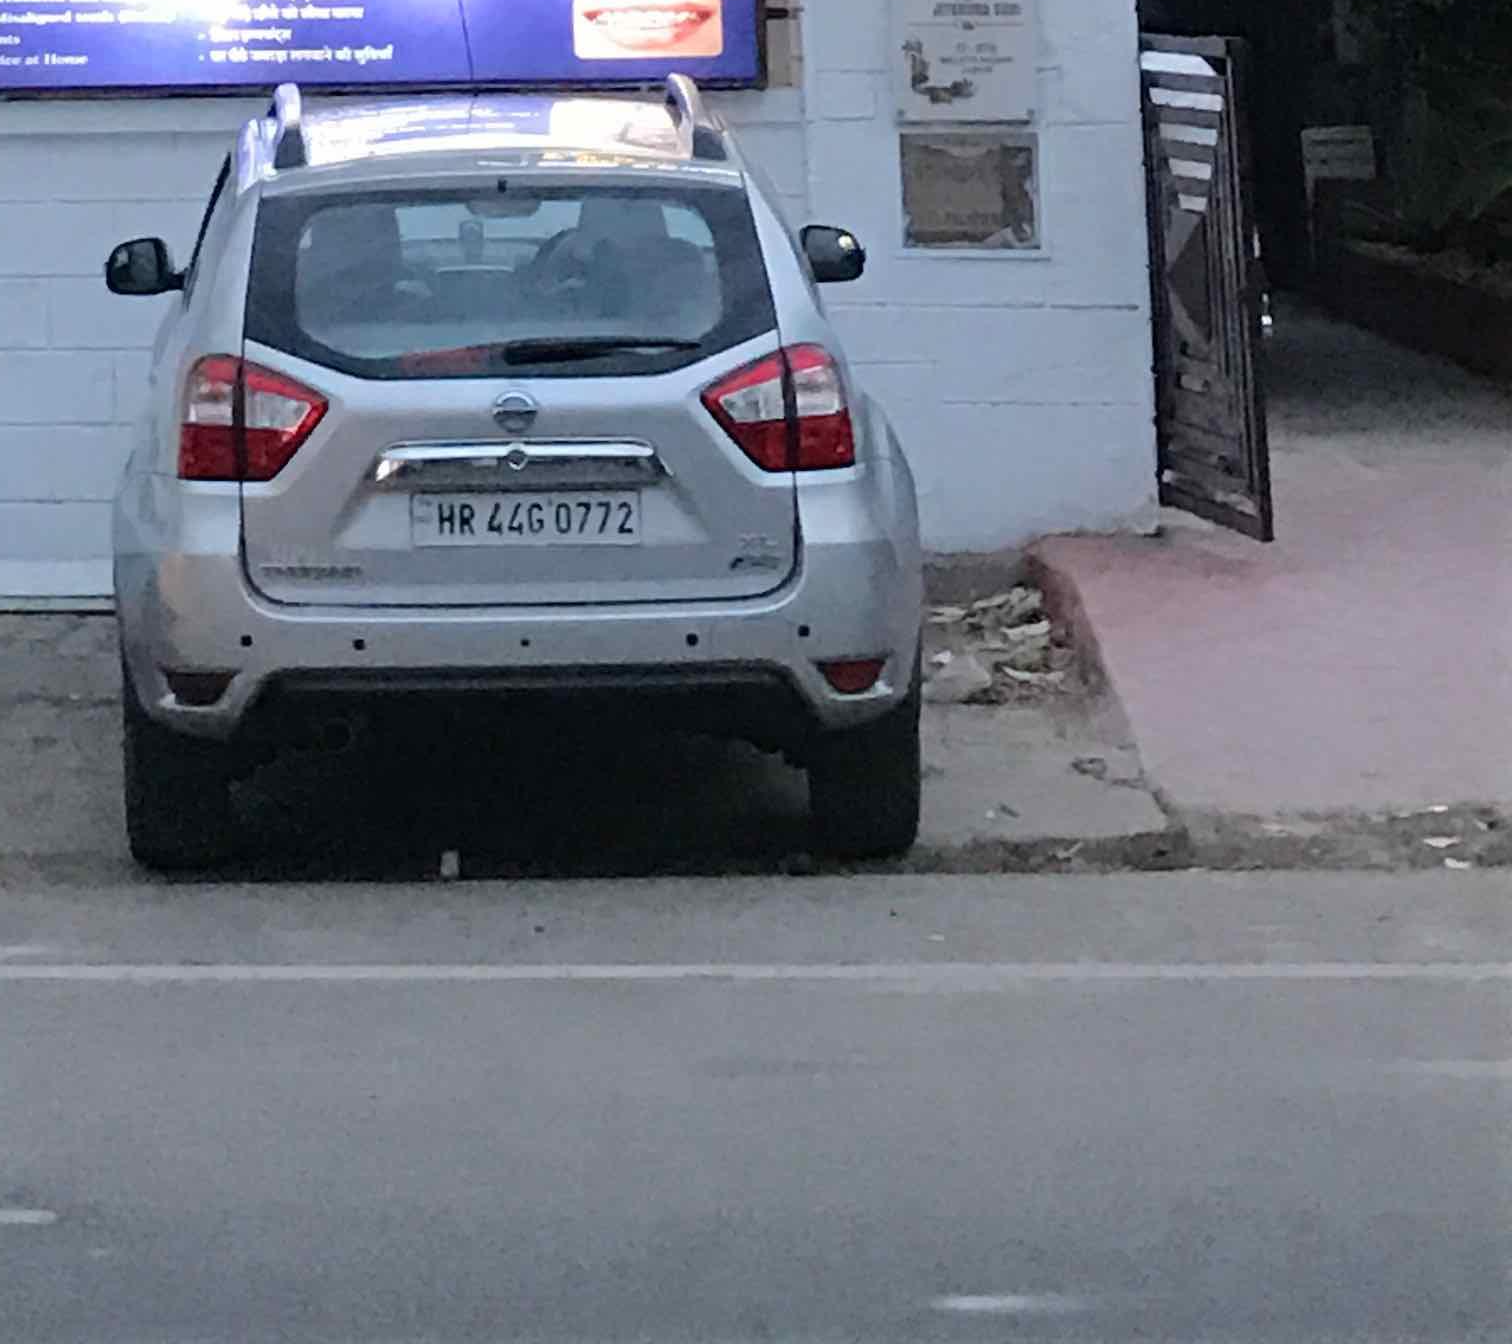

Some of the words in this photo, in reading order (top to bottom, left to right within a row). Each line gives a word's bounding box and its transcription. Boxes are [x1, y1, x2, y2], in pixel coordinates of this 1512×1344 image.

[44, 52, 89, 65] Home
[438, 503, 475, 535] HR
[554, 501, 634, 534] 0772
